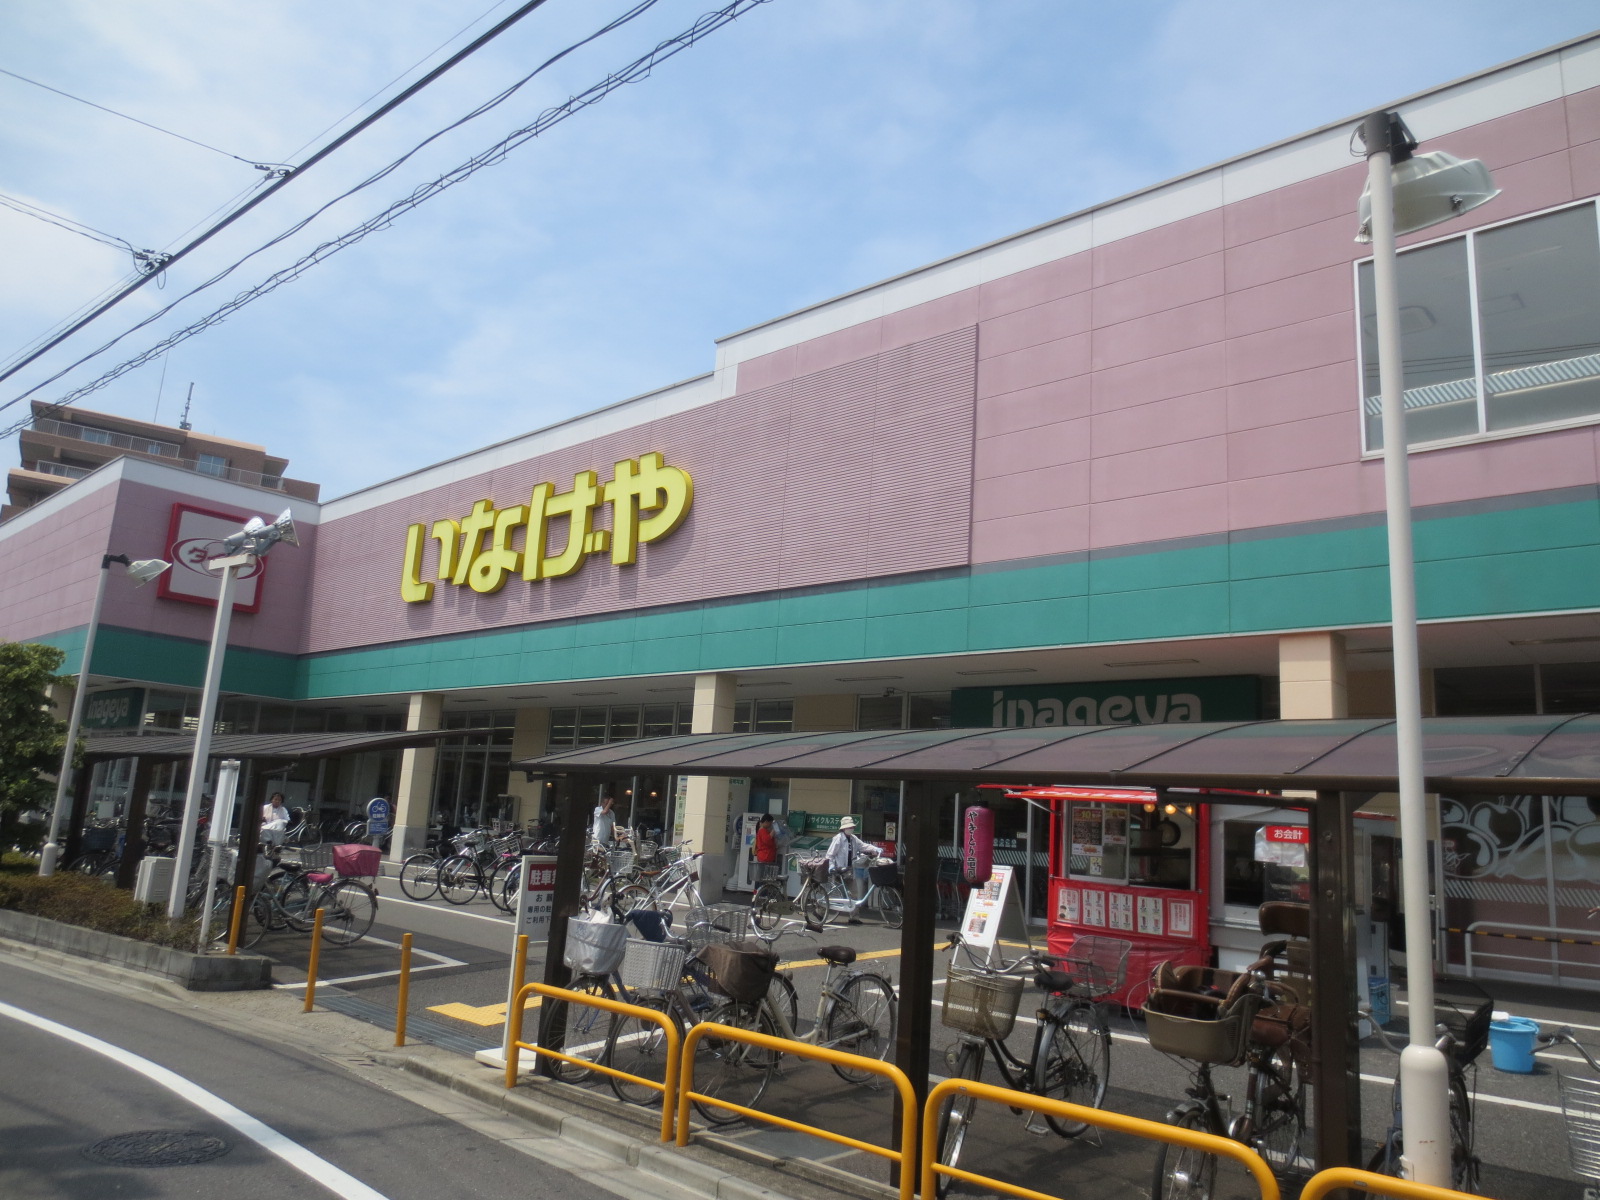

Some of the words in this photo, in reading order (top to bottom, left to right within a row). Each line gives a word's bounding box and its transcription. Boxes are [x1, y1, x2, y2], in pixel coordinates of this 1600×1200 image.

[400, 451, 695, 604] いなげや
[87, 697, 130, 725] inageya
[1273, 829, 1303, 840] お会計
